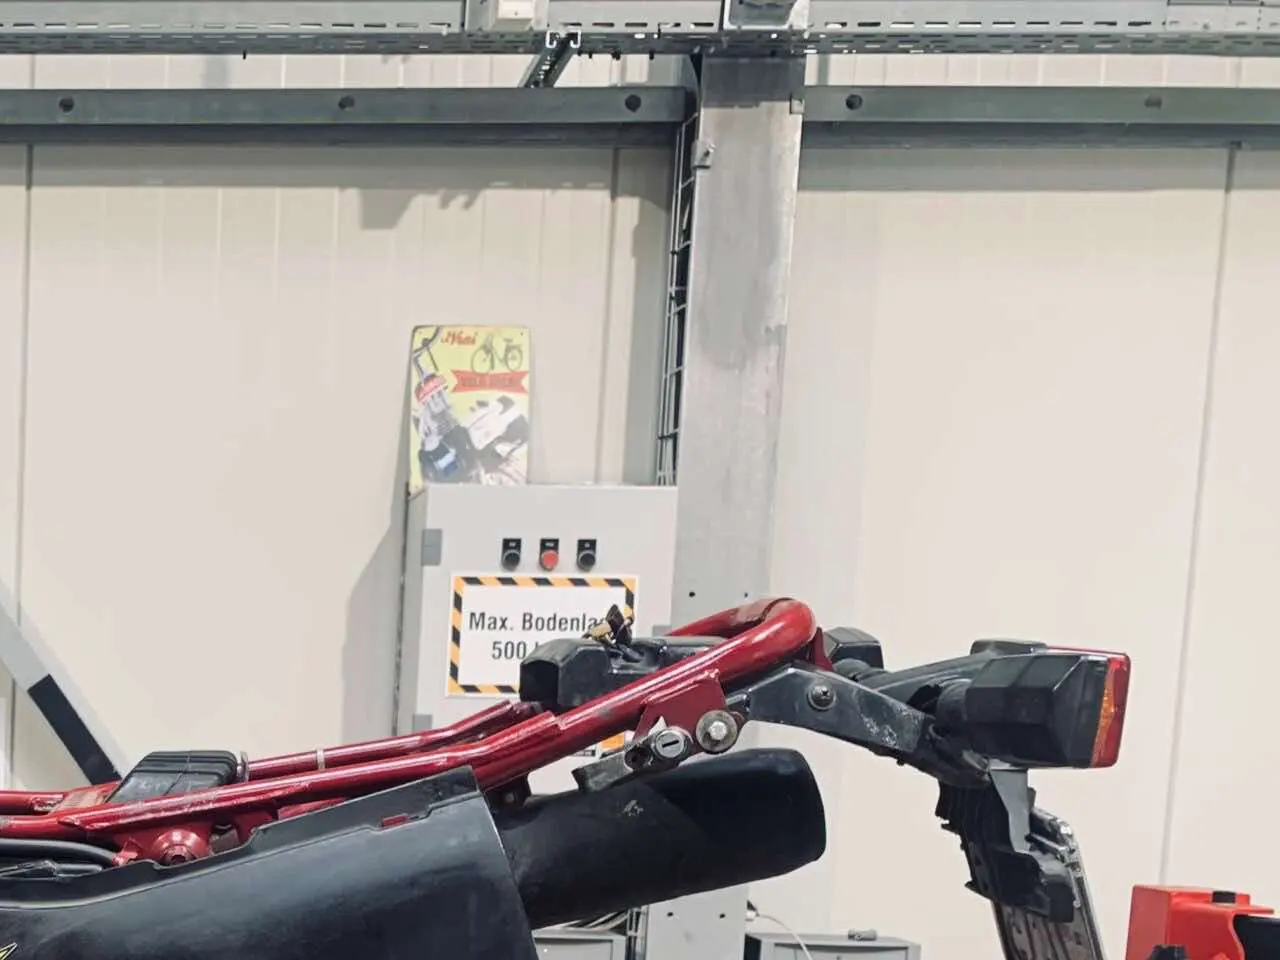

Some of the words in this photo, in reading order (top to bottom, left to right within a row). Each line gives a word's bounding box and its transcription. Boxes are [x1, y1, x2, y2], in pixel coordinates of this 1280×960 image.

[468, 612, 514, 631] Max.
[521, 612, 608, 632] Bodenla
[492, 640, 527, 660] 500
